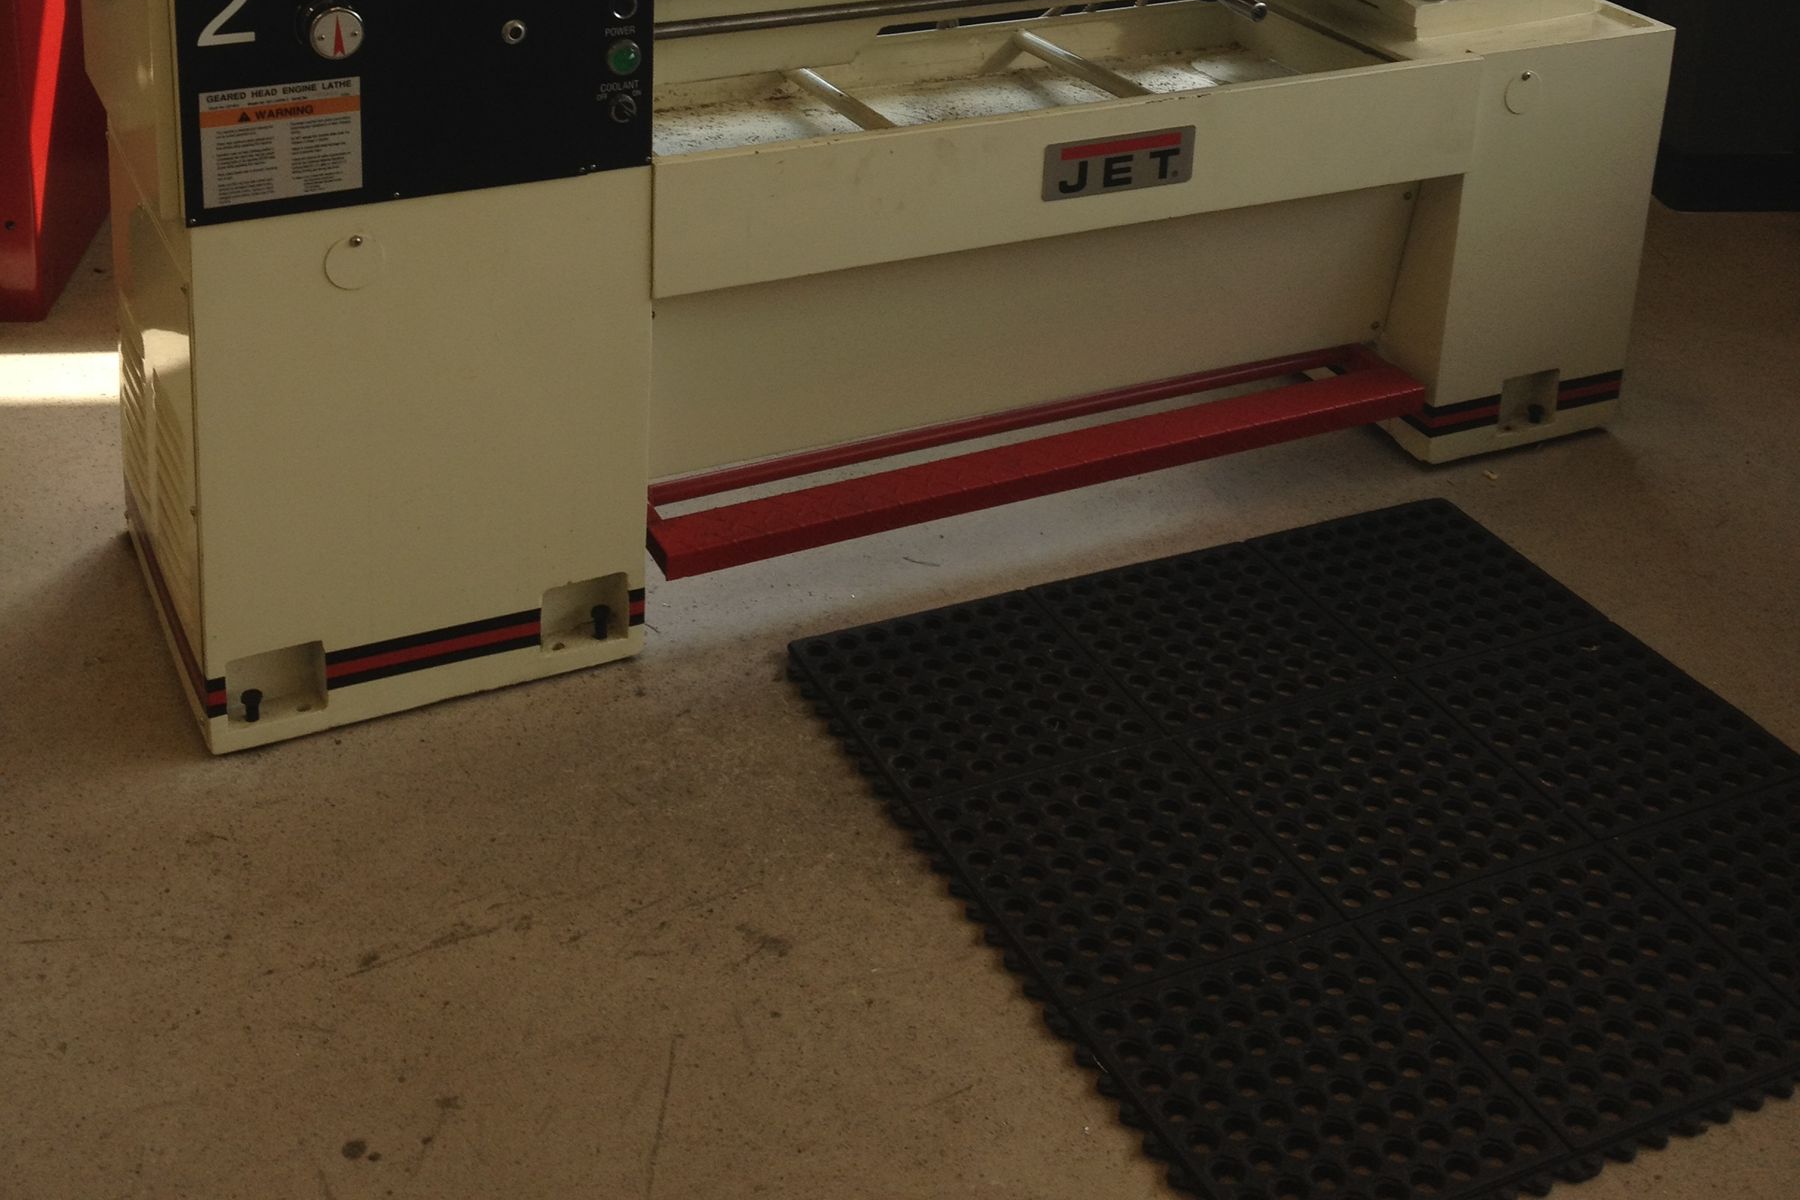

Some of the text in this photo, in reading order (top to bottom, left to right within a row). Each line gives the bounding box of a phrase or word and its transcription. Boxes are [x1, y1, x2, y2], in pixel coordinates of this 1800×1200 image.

[604, 25, 636, 37] POWER
[206, 92, 247, 104] GEARED
[251, 88, 278, 98] HEAD
[282, 83, 317, 94] ENGINE
[321, 79, 352, 90] LATHE
[600, 80, 639, 93] COOLANT
[255, 105, 314, 121] WARNING
[1058, 147, 1181, 194] JET
